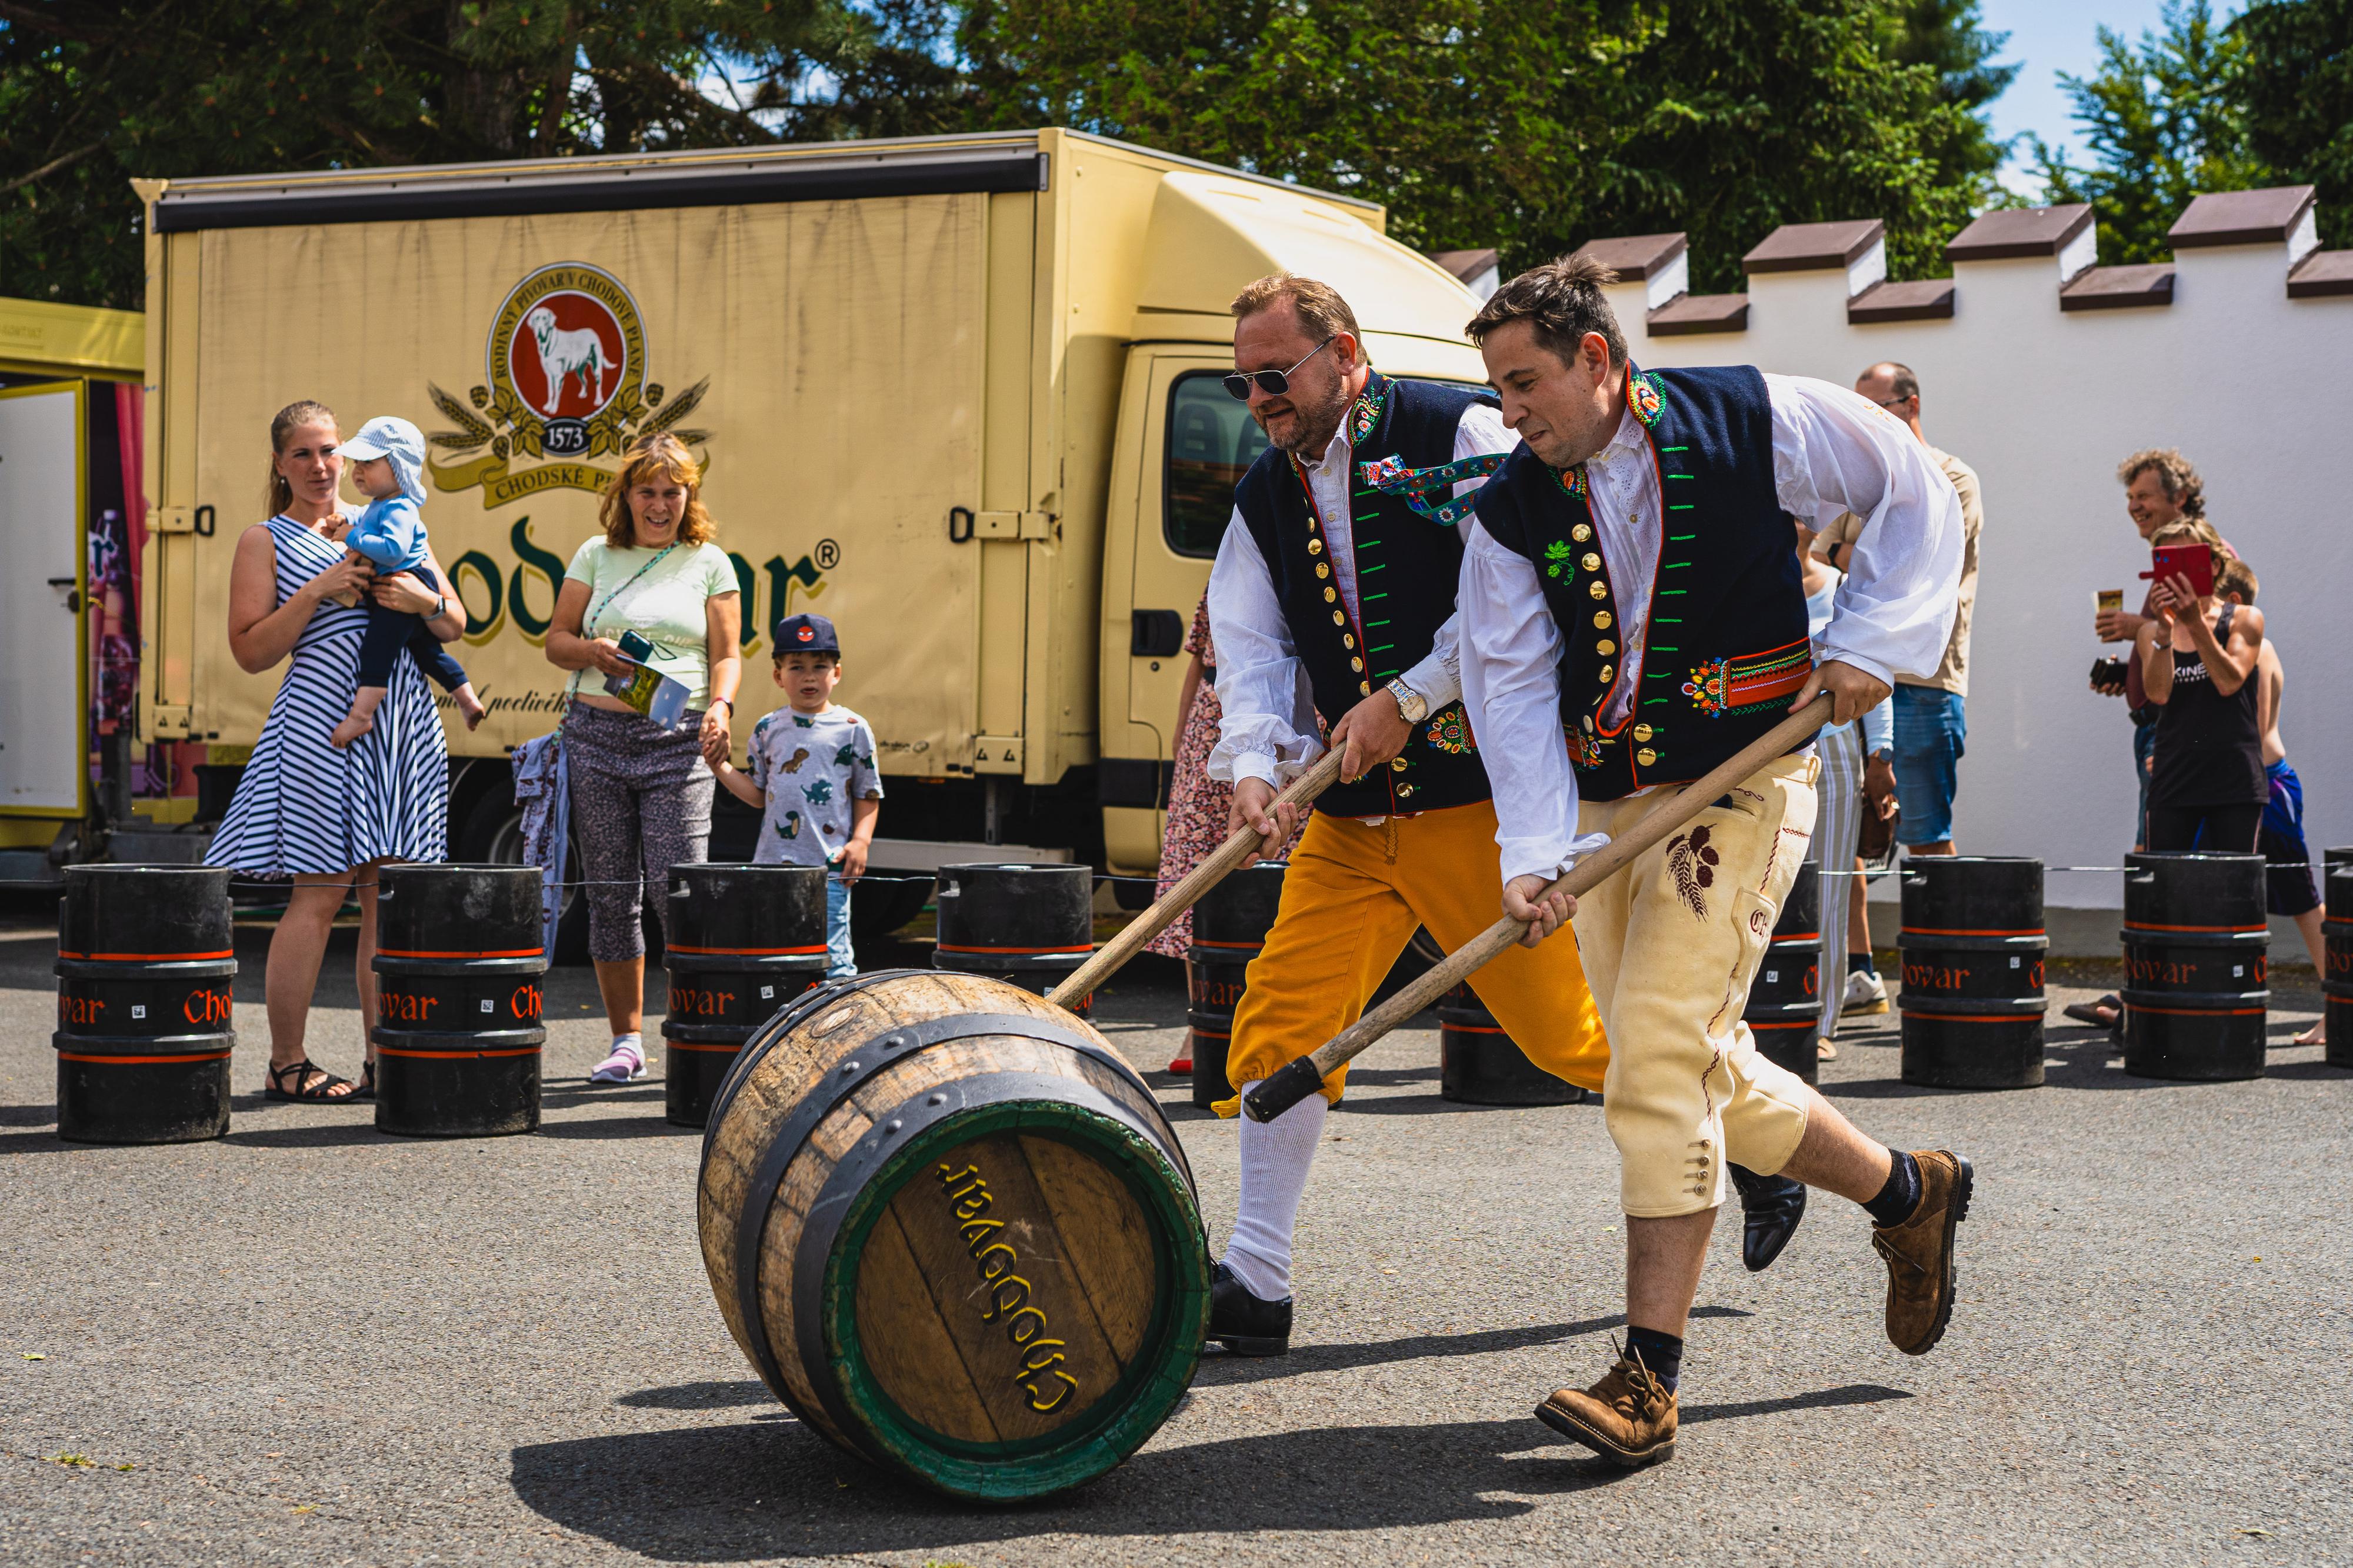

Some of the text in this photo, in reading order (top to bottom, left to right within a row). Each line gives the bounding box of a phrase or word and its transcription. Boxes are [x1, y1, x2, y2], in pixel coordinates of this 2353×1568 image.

[515, 272, 565, 310] PIVOVAR
[548, 426, 584, 449] 1573
[496, 466, 584, 499] CHODSKÉ
[2174, 662, 2208, 678] KINE
[668, 987, 735, 1015] ovar
[936, 1163, 1079, 1413] Chodovar
